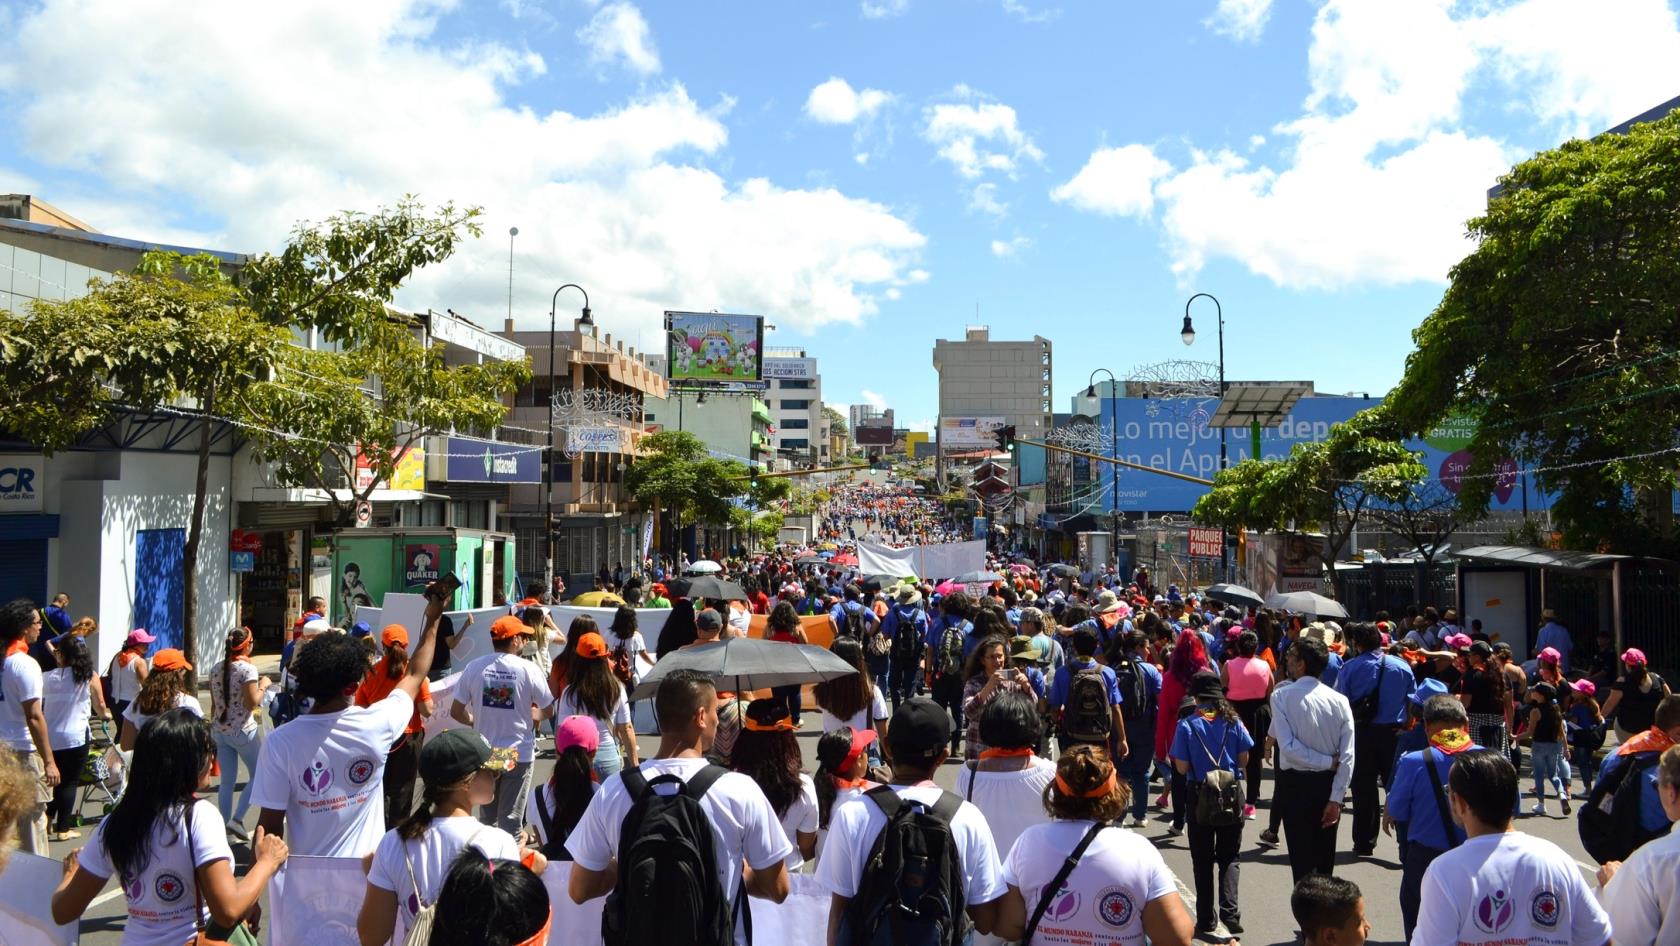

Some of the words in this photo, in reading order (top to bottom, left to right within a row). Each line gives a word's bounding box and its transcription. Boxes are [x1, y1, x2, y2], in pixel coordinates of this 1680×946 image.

[1111, 416, 1141, 439] Lo
[1279, 414, 1343, 442] dep
[1431, 428, 1472, 439] GRATIS
[1150, 447, 1170, 471] el
[1448, 462, 1463, 473] Sin
[407, 570, 438, 581] QUAKER
[1288, 581, 1317, 590] NAVEGA
[1044, 927, 1065, 936] MUNDO
[1065, 930, 1093, 940] NARANJA
